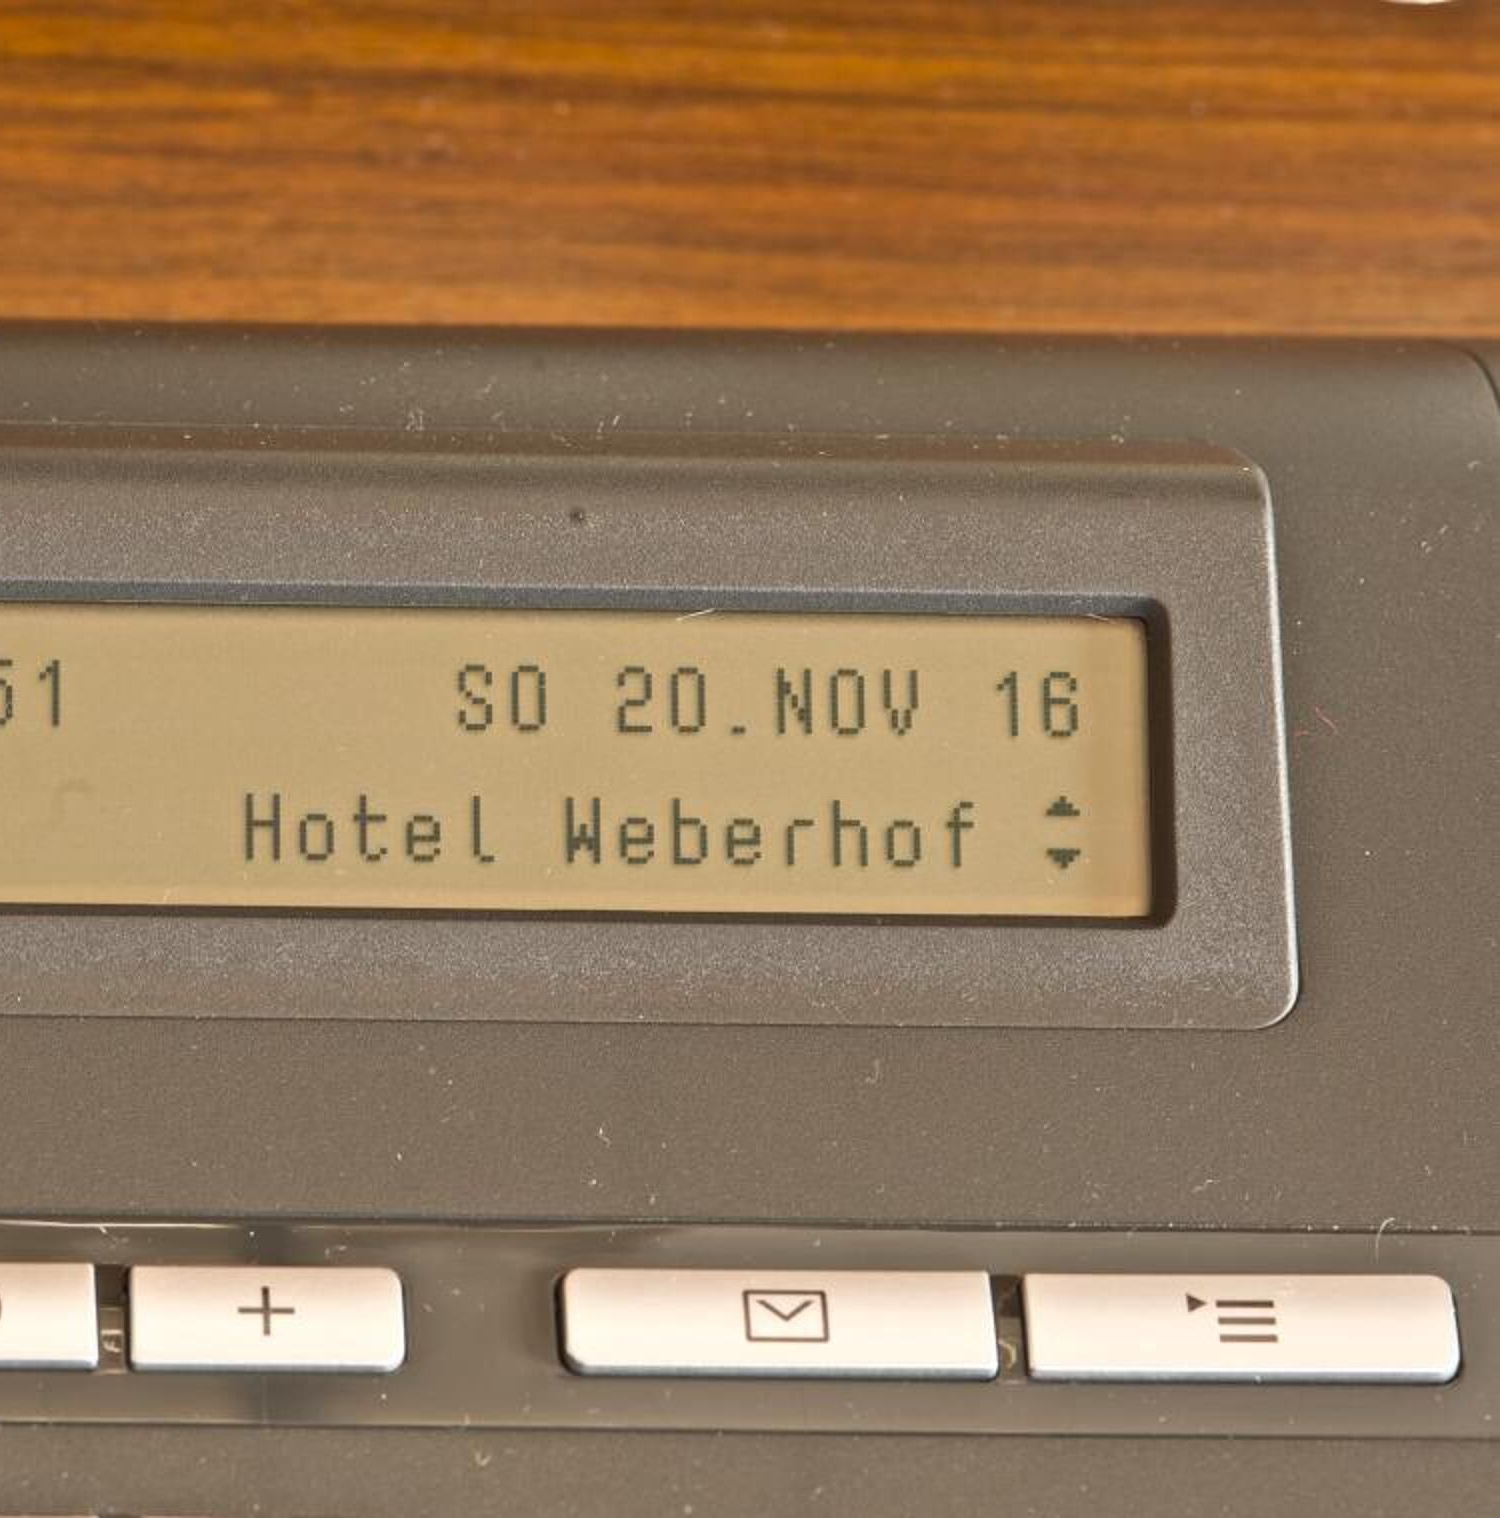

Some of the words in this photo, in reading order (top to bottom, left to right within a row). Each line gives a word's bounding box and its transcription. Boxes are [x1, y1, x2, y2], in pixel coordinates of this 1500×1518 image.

[456, 664, 548, 732] SO
[616, 666, 919, 736] 20.NOV
[996, 670, 1079, 738] 16
[244, 793, 495, 863] Hotel
[564, 797, 975, 869] Weberhof
